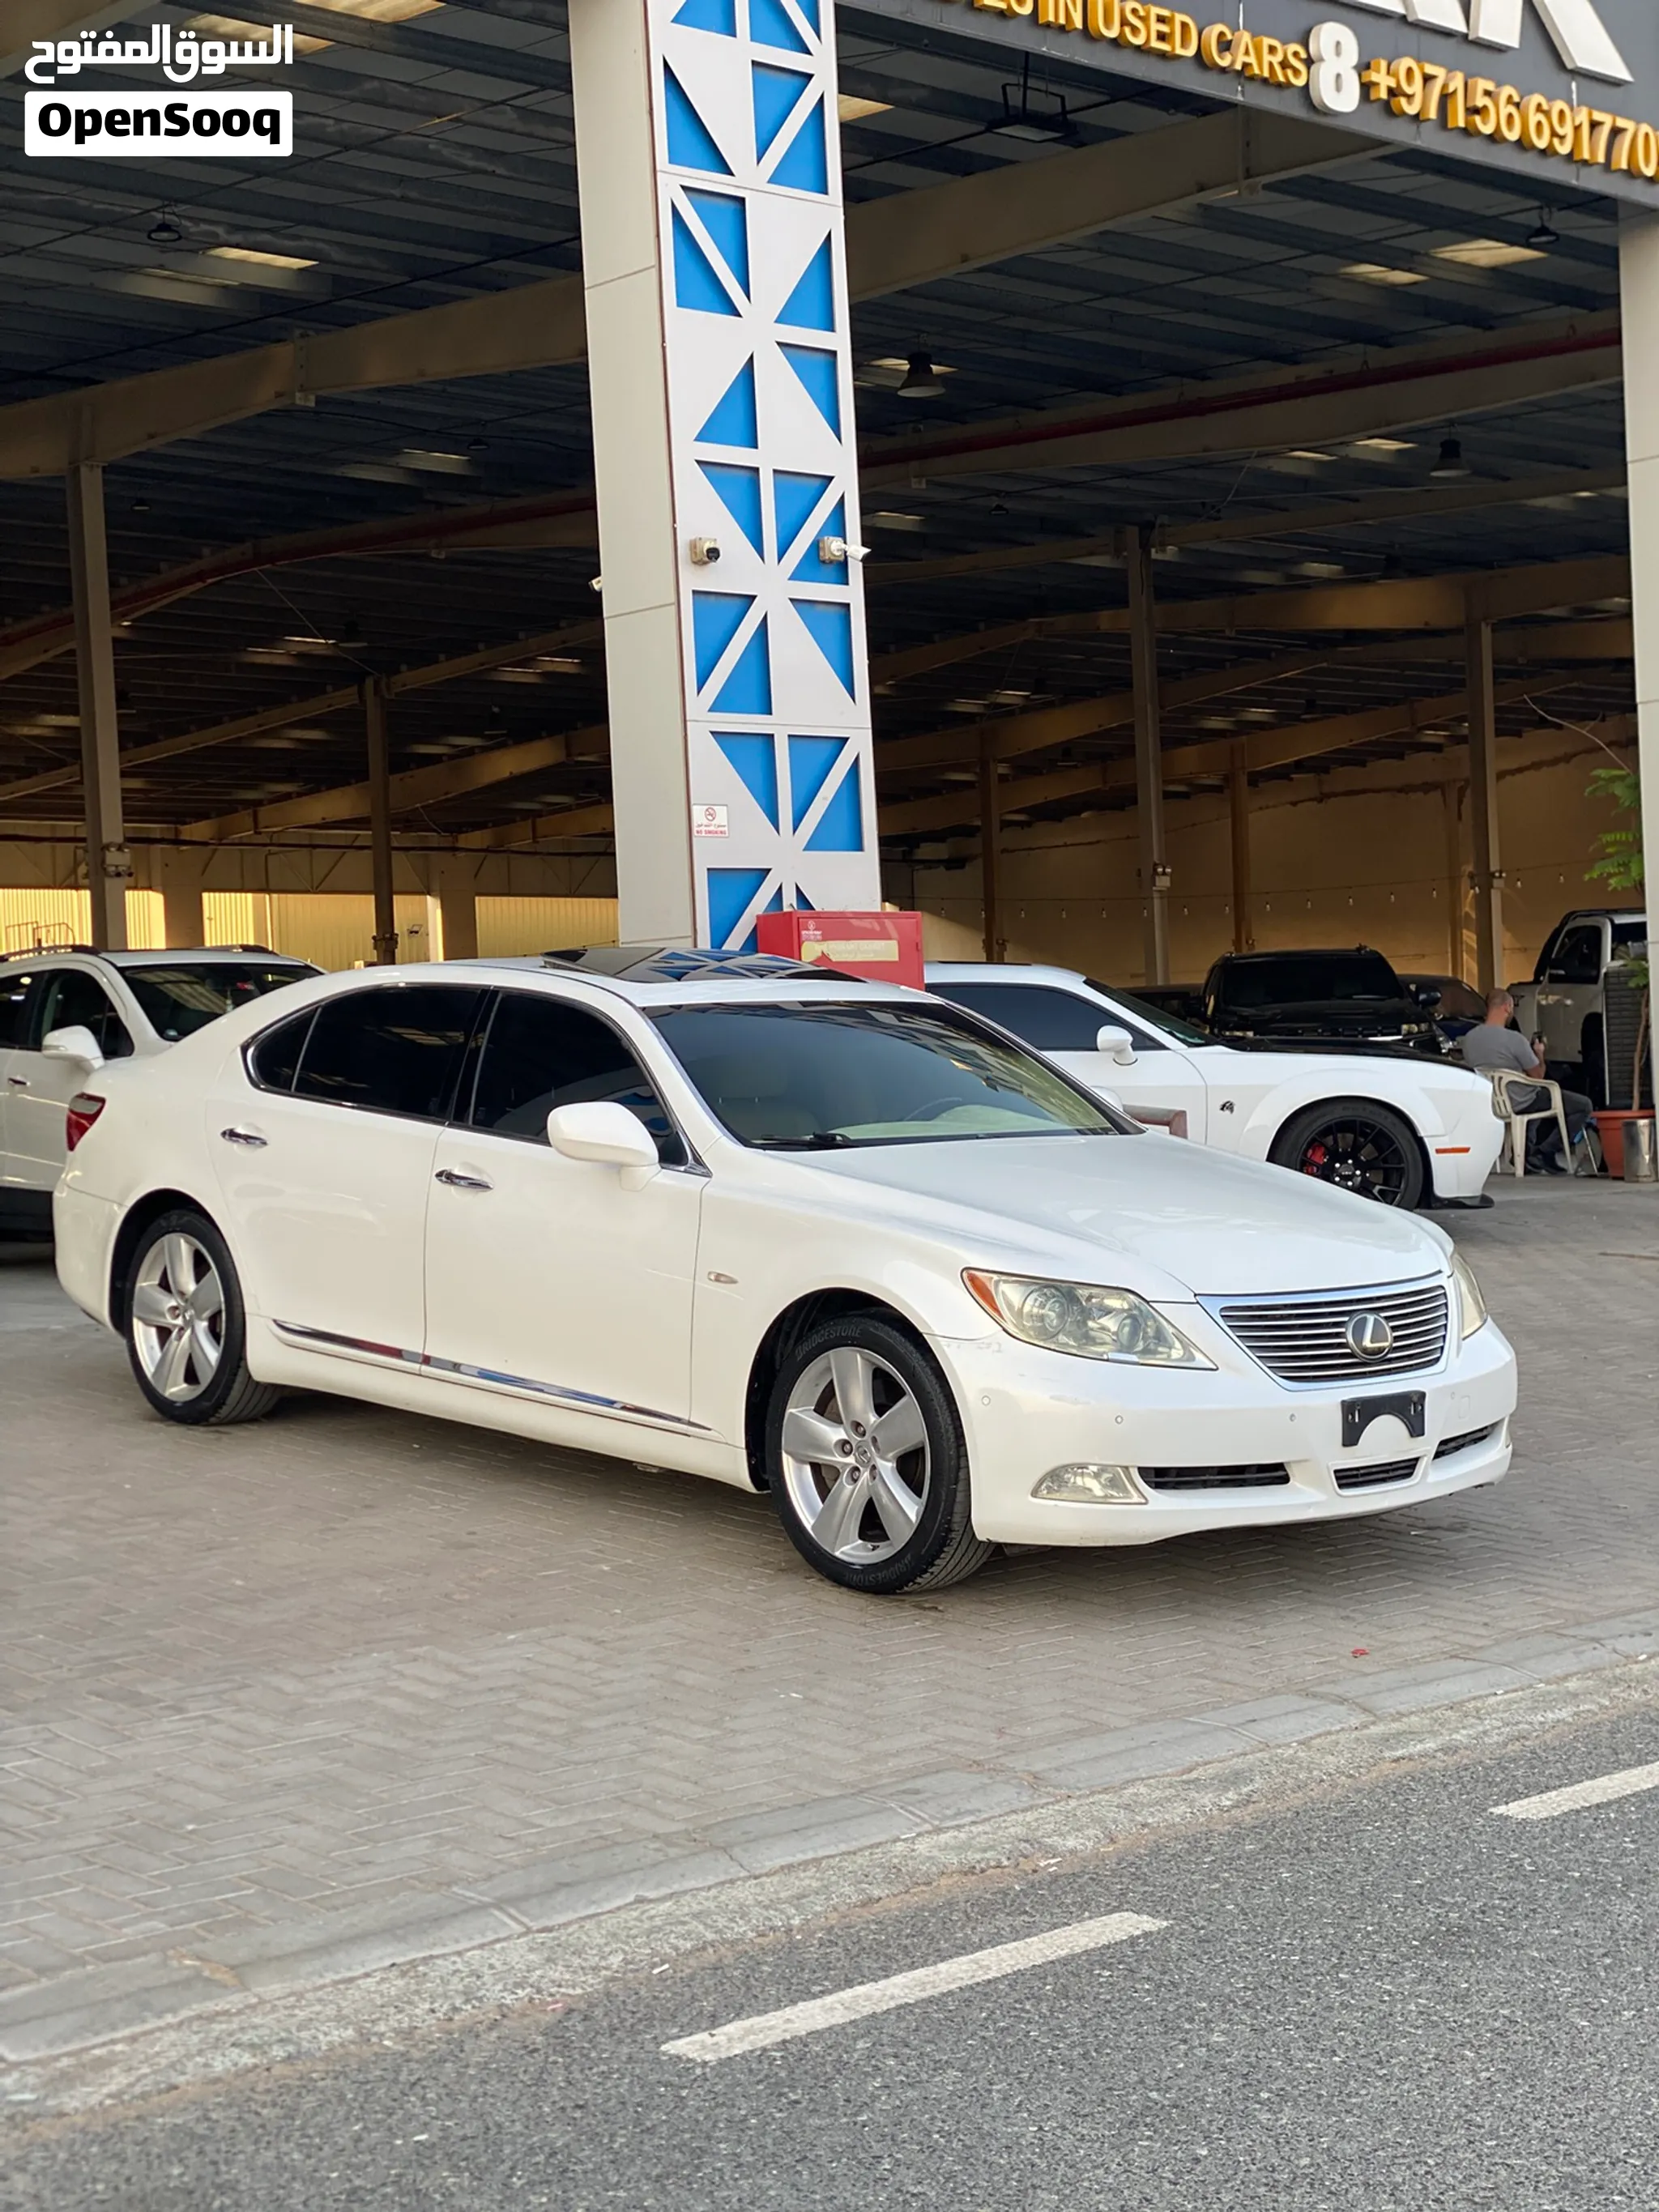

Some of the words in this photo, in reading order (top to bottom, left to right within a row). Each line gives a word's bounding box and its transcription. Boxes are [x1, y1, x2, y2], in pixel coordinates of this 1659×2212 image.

[1087, 0, 1199, 58] USED
[1201, 23, 1308, 88] CARS
[795, 1325, 862, 1362] BRIDGESTONE
